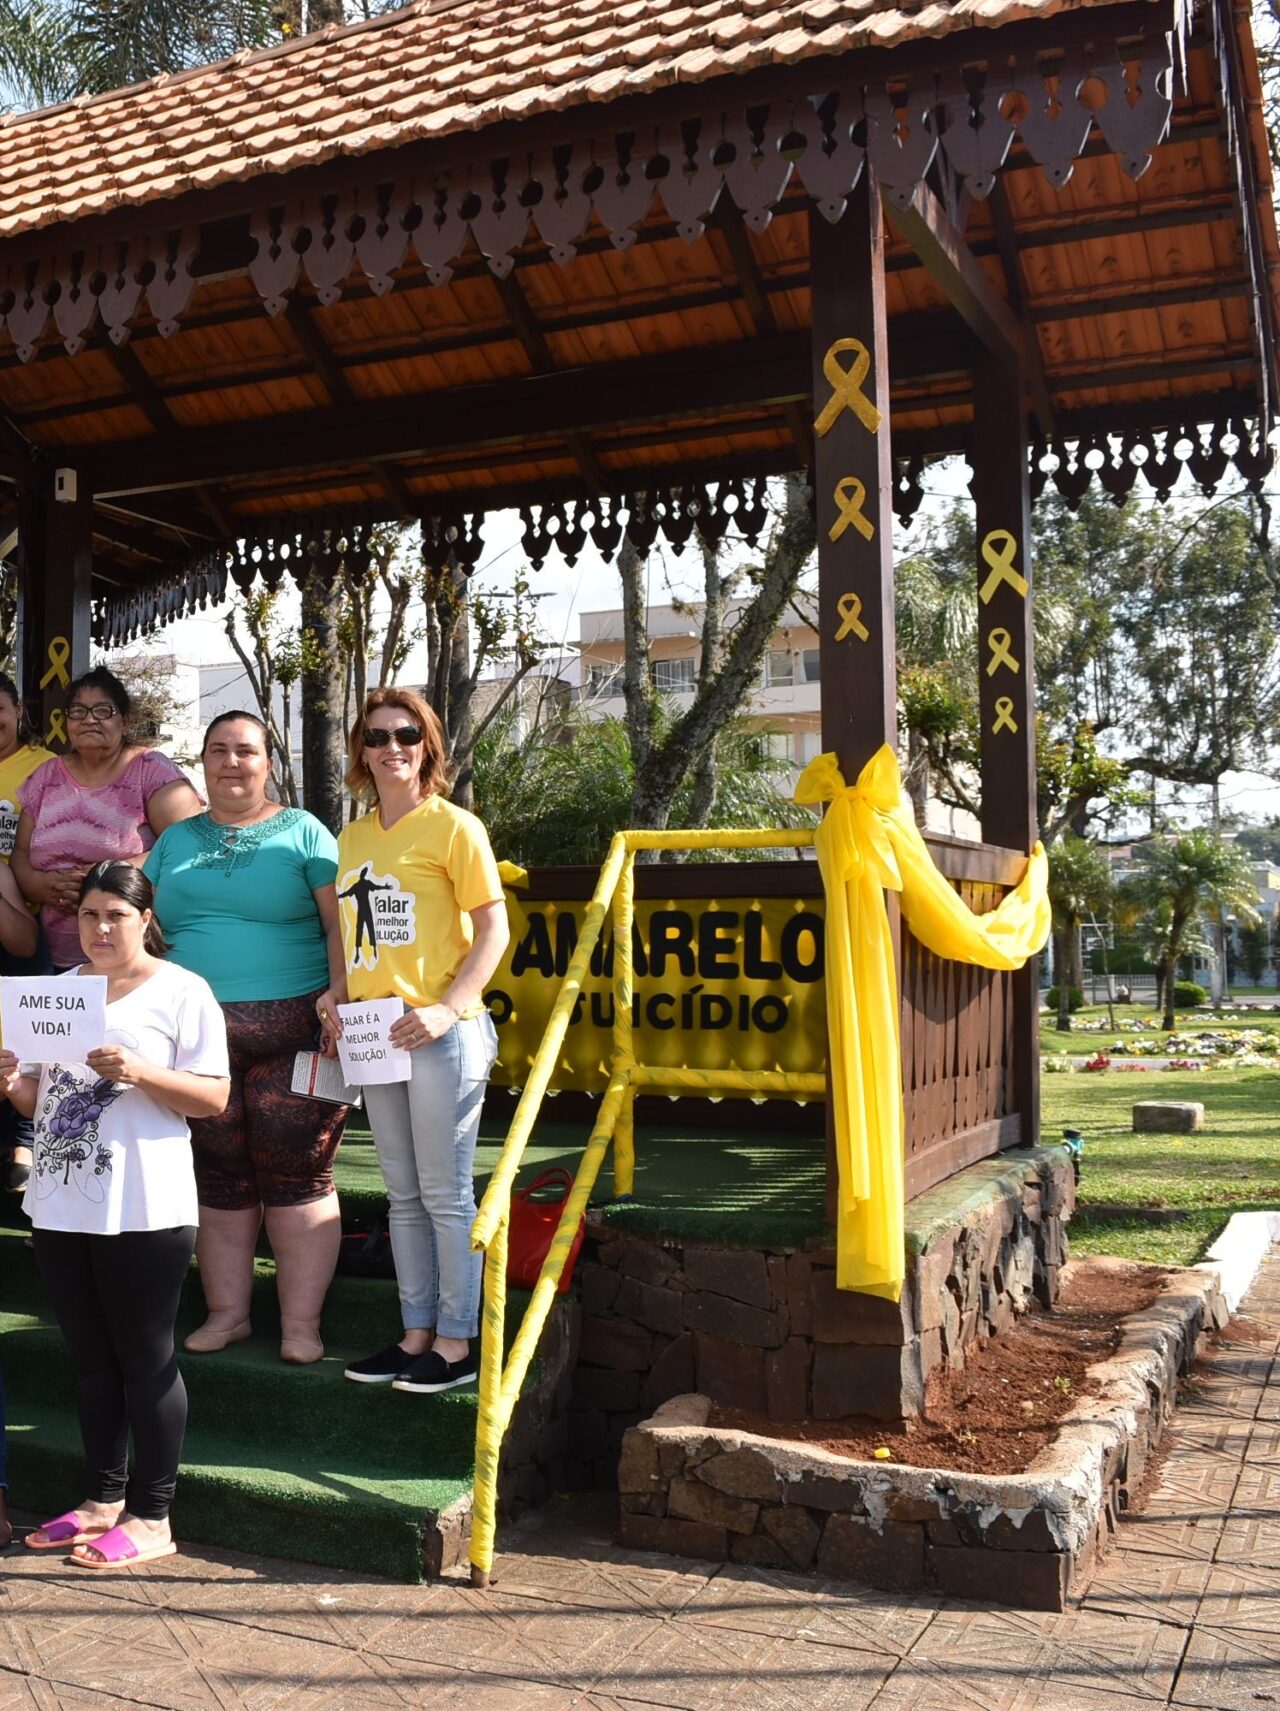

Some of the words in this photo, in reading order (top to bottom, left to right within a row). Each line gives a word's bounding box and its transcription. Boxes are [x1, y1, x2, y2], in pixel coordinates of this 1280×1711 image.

[376, 929, 409, 943] LUÇÃO
[510, 910, 825, 983] AMARELO
[19, 995, 52, 1009] AME
[55, 996, 86, 1011] SUA
[339, 1015, 364, 1027] FALAR
[366, 1011, 372, 1024] É
[373, 1013, 380, 1023] A
[31, 1021, 71, 1036] VIDA!
[345, 1032, 380, 1044] MELHOR
[348, 1048, 387, 1063] SOLUÇÃO!
